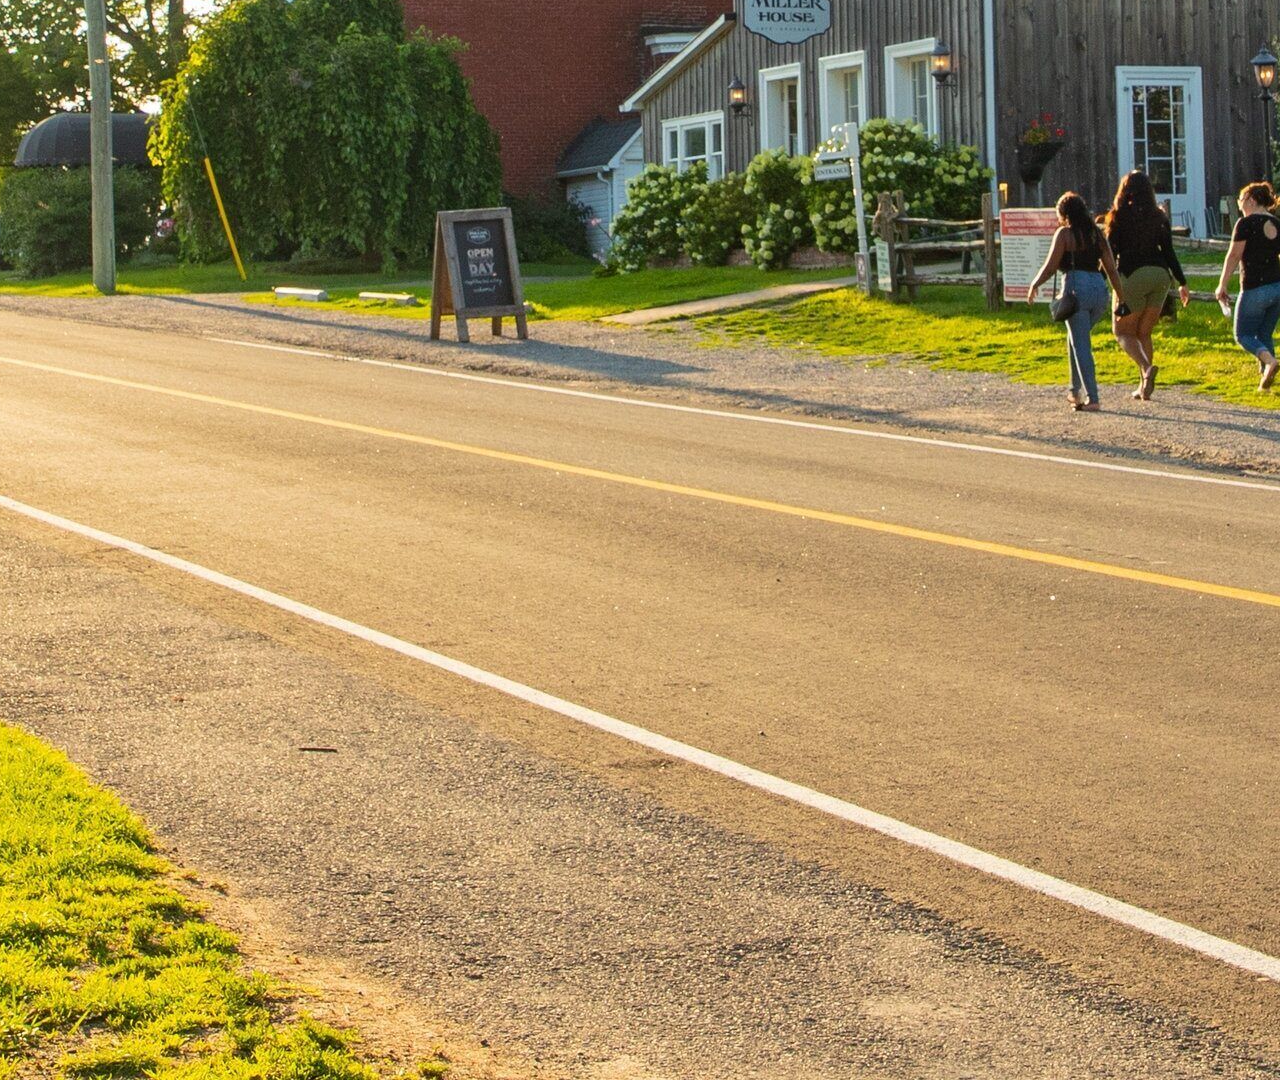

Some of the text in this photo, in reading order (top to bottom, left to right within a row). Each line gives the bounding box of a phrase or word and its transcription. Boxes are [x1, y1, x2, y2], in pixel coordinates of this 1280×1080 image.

[757, 11, 815, 23] HOUSE
[816, 167, 848, 176] ENTRANCE
[467, 248, 494, 258] OPEN
